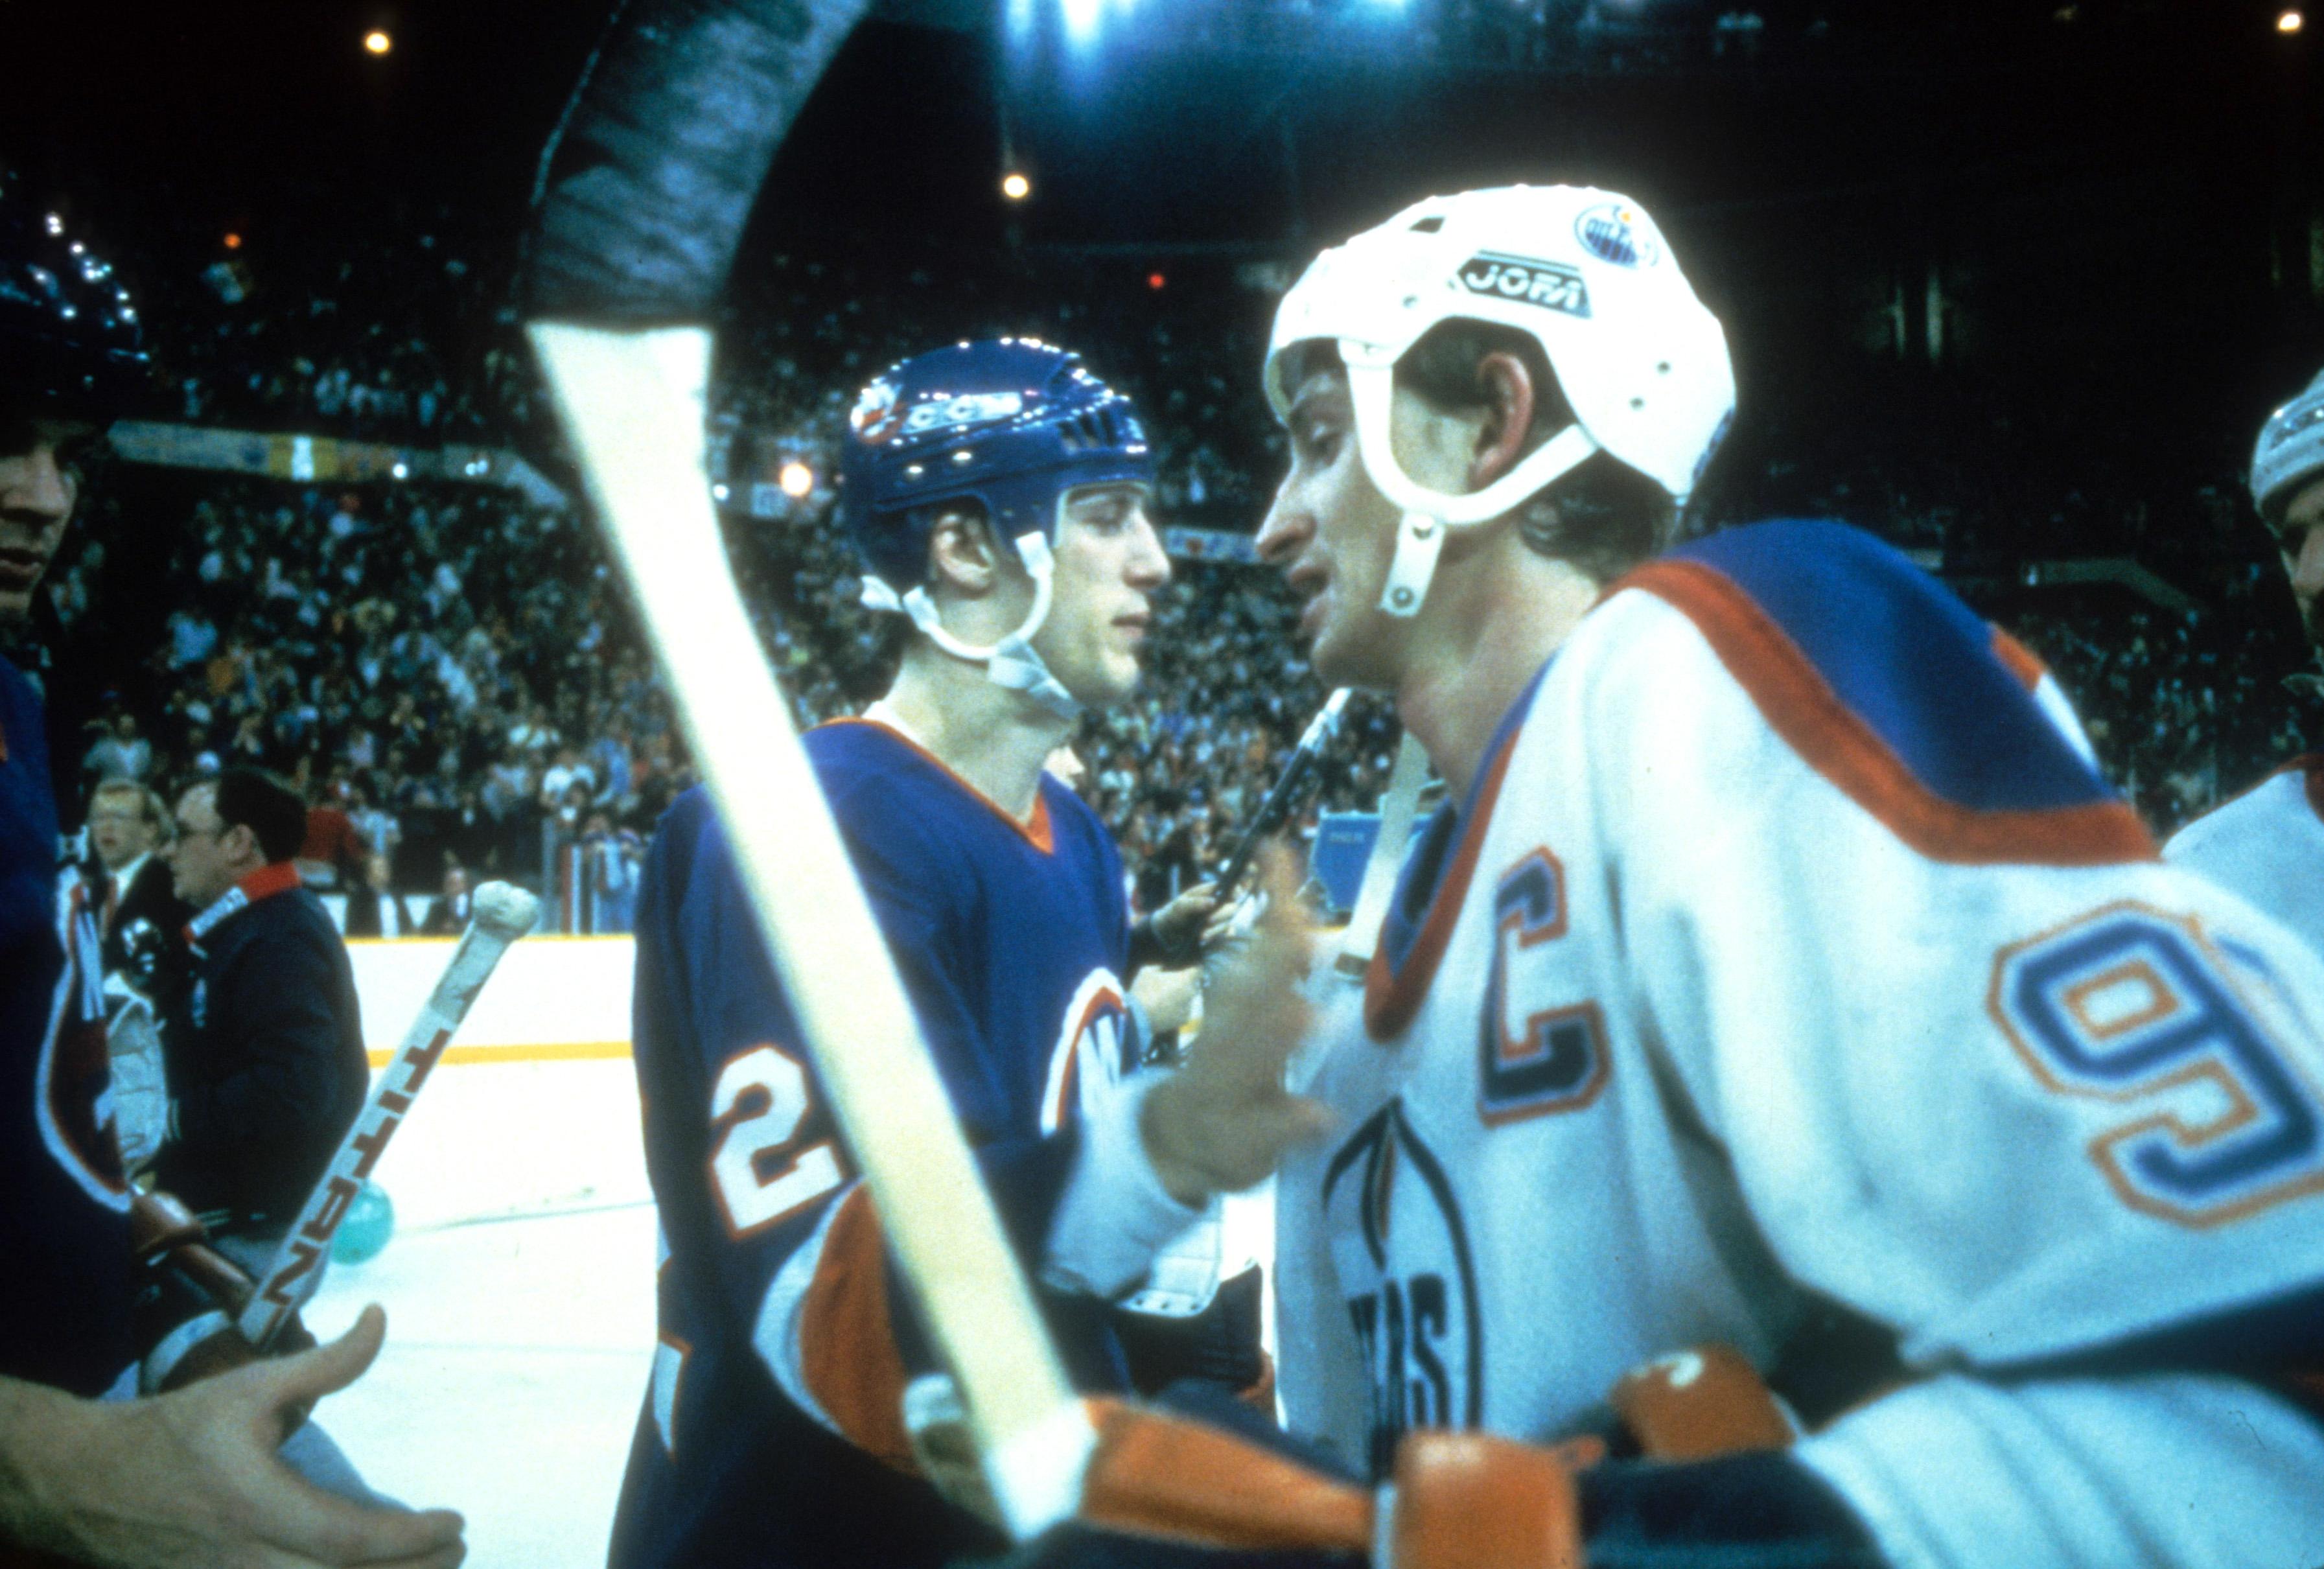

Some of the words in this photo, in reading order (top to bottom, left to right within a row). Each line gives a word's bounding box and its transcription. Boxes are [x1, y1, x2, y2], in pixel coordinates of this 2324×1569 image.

[1465, 264, 1582, 311] JOFA
[1475, 844, 1612, 1131] C
[1986, 896, 2324, 1229] 9
[262, 1027, 453, 1307] TITAN
[708, 1040, 850, 1242] 2
